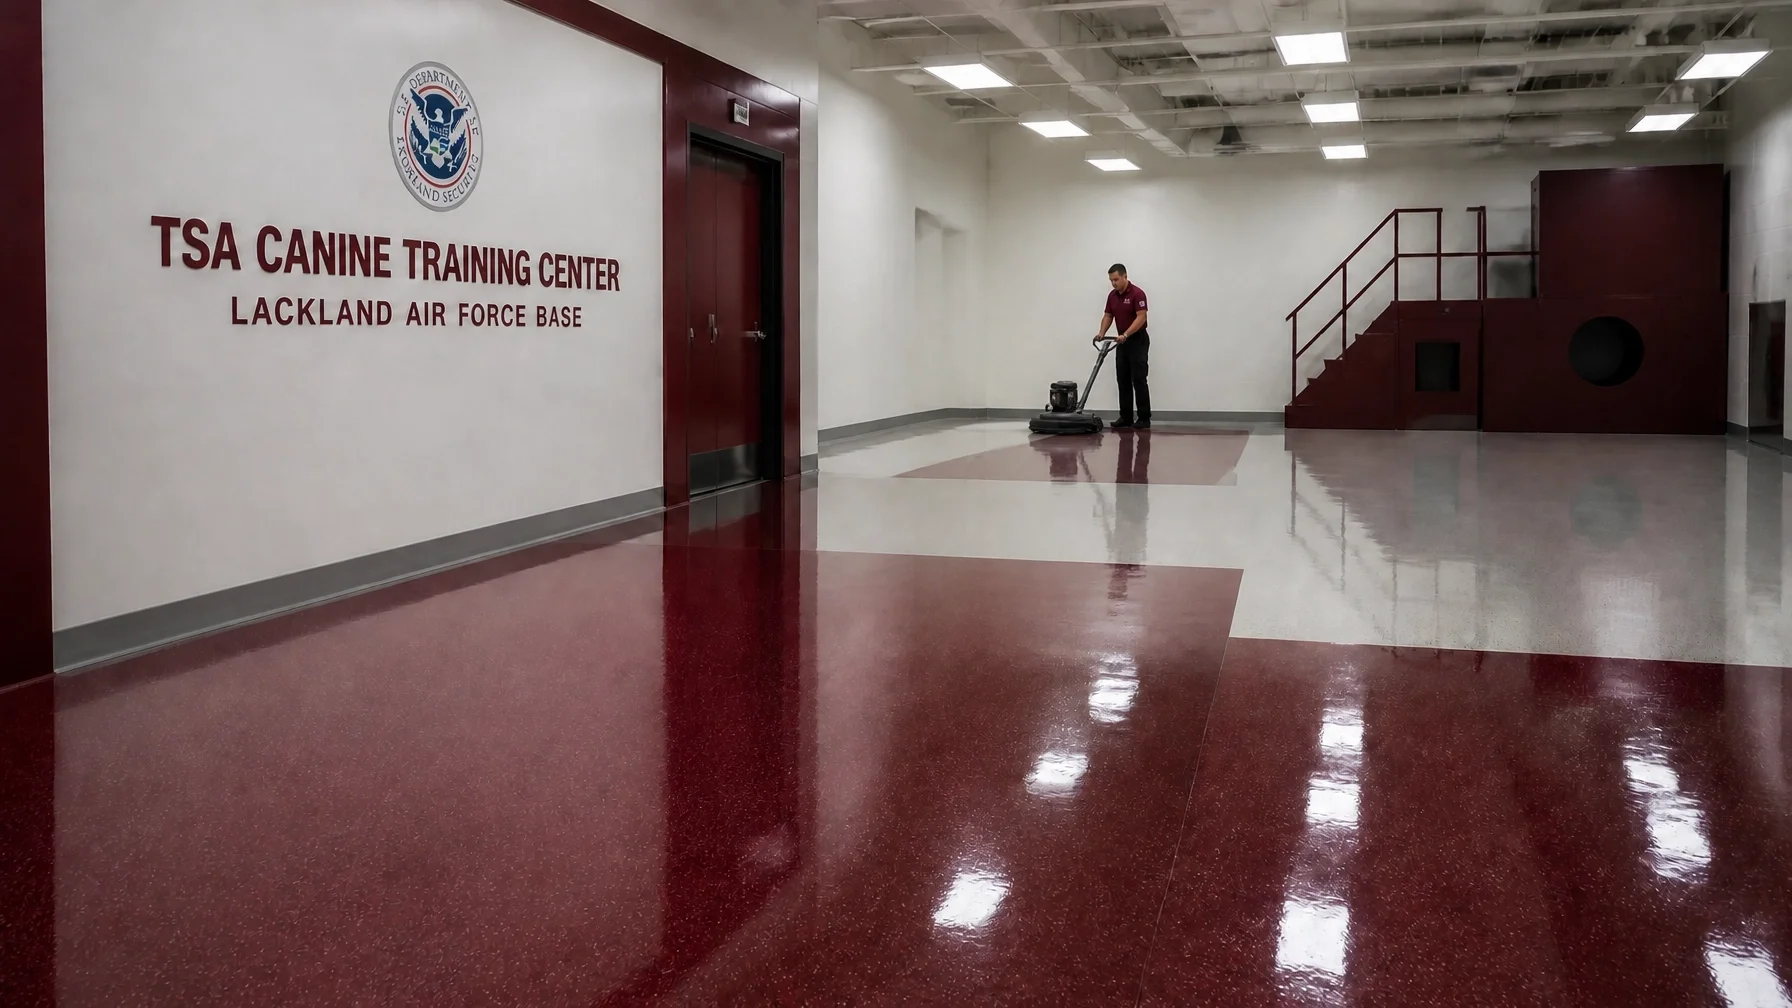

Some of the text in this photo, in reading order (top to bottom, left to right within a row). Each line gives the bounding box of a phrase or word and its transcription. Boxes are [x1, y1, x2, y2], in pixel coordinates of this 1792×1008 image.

[151, 215, 621, 292] TSA CANINE TRAINING CENTER
[232, 297, 583, 328] LACKLAND AIR FORCE BASE
